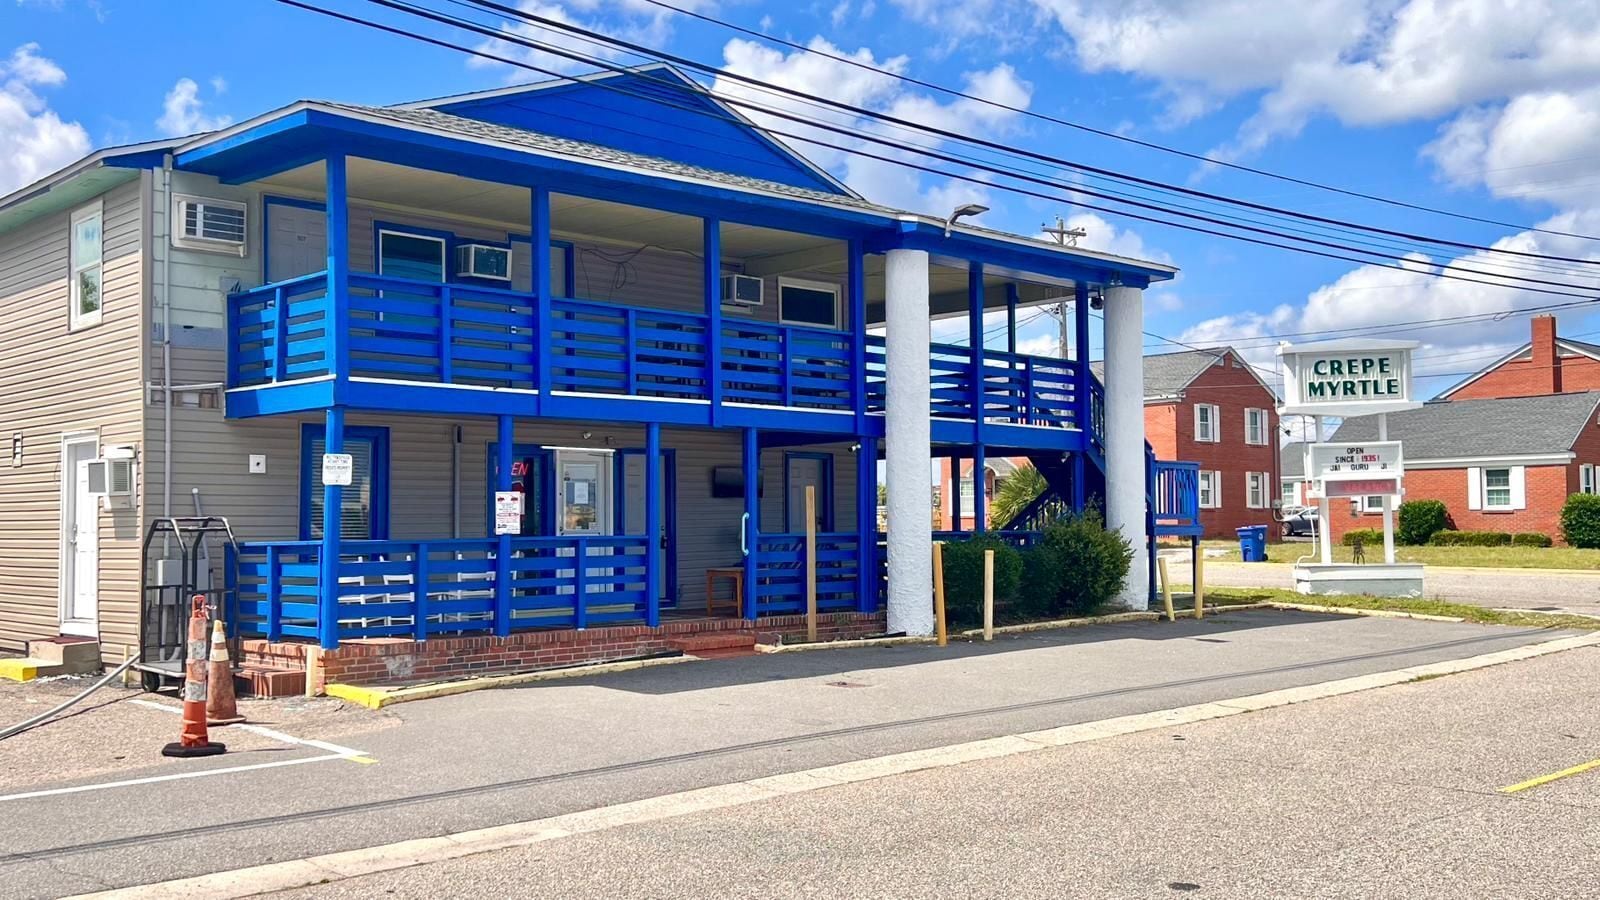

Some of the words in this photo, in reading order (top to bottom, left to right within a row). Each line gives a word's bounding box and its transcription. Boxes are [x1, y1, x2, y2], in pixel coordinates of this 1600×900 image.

[1313, 357, 1390, 376] CREPE
[1308, 379, 1399, 397] MYRTLE
[1346, 447, 1364, 455] OPEN
